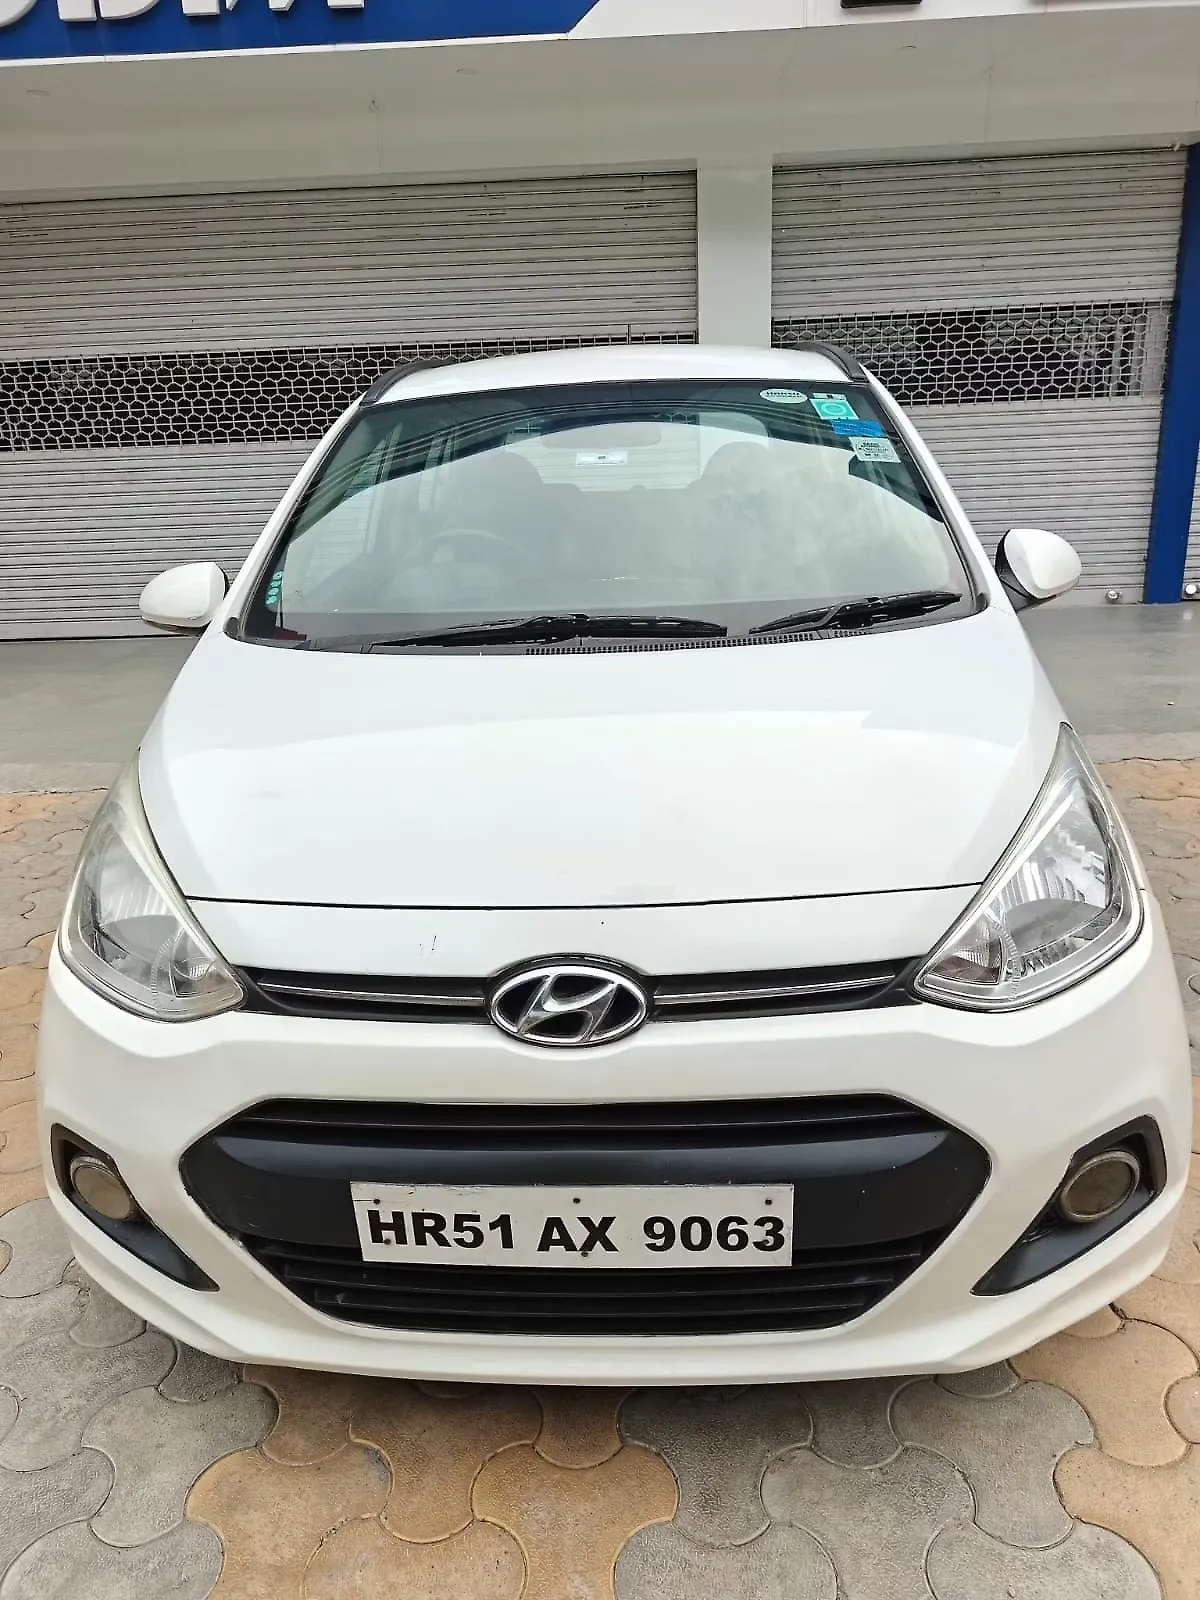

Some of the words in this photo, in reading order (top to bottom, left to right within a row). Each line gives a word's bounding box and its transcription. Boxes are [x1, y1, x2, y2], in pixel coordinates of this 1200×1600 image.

[367, 1209, 514, 1249] HR51
[536, 1216, 619, 1252] AX
[643, 1215, 785, 1252] 9063
